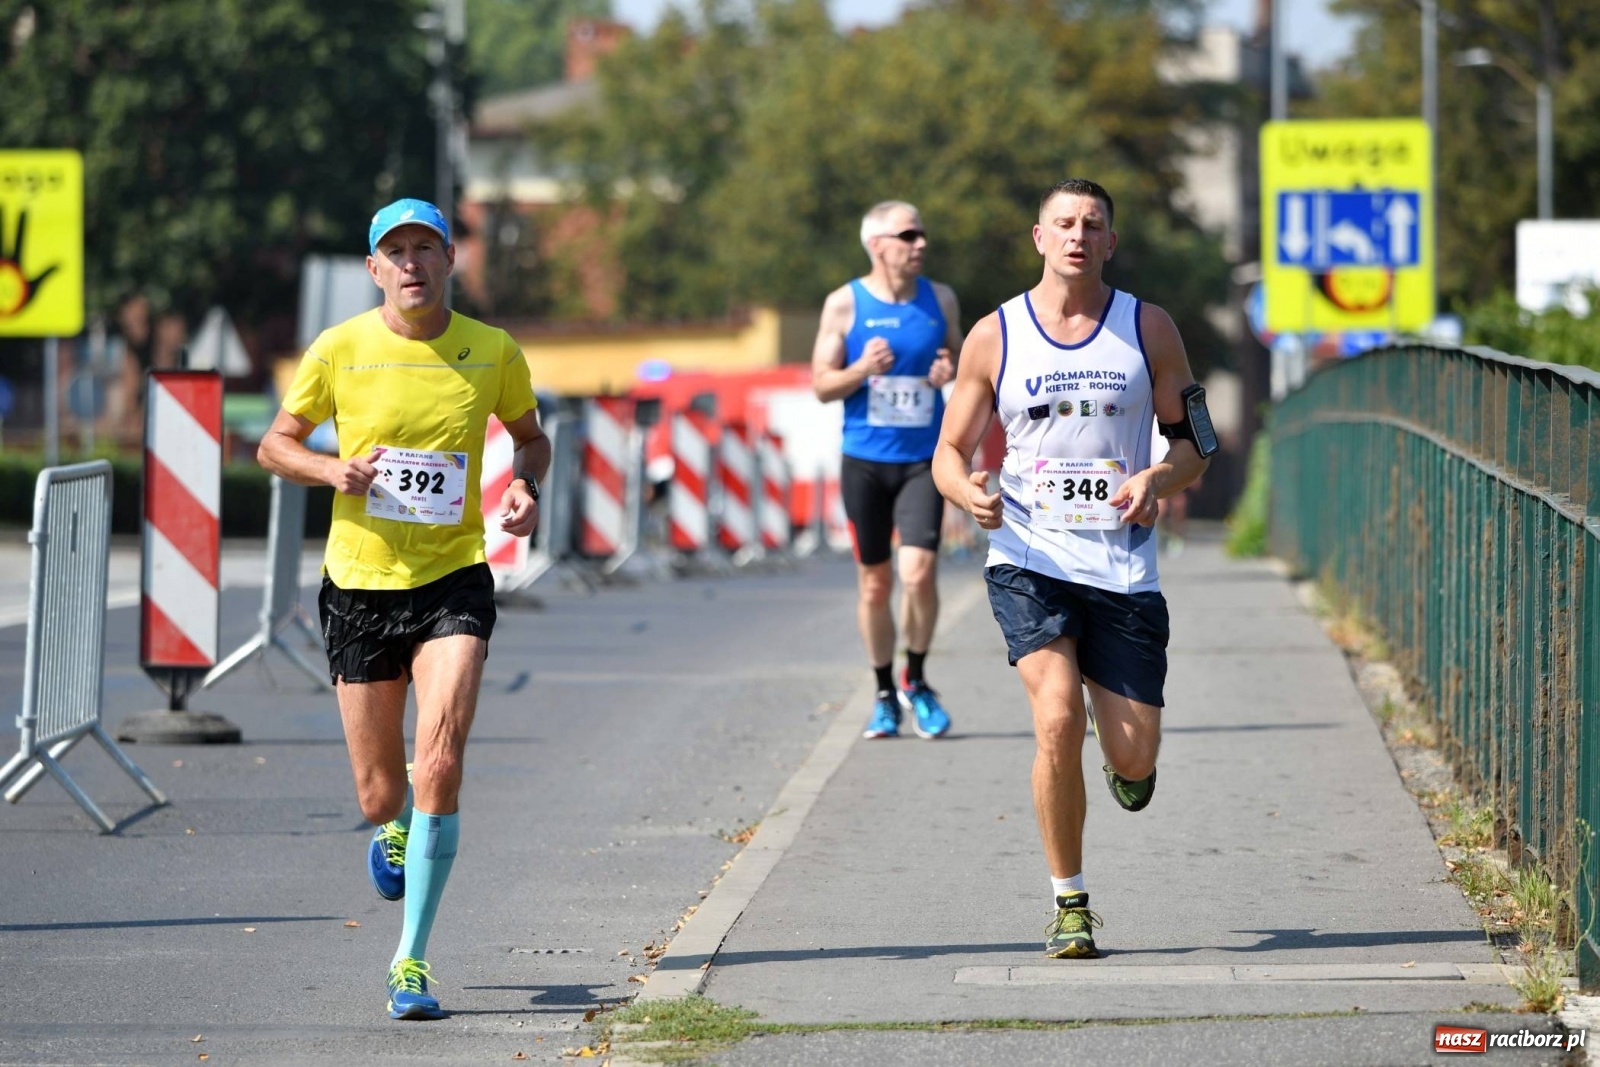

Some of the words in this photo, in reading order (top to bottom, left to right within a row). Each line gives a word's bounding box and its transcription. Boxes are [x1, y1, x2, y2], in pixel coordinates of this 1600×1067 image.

[1025, 376, 1042, 397] V
[1045, 370, 1126, 383] PÓŁMARATON
[1045, 382, 1080, 394] KIETRZ
[1089, 382, 1127, 392] ROHOV
[399, 469, 445, 494] 392
[1063, 478, 1108, 501] 348
